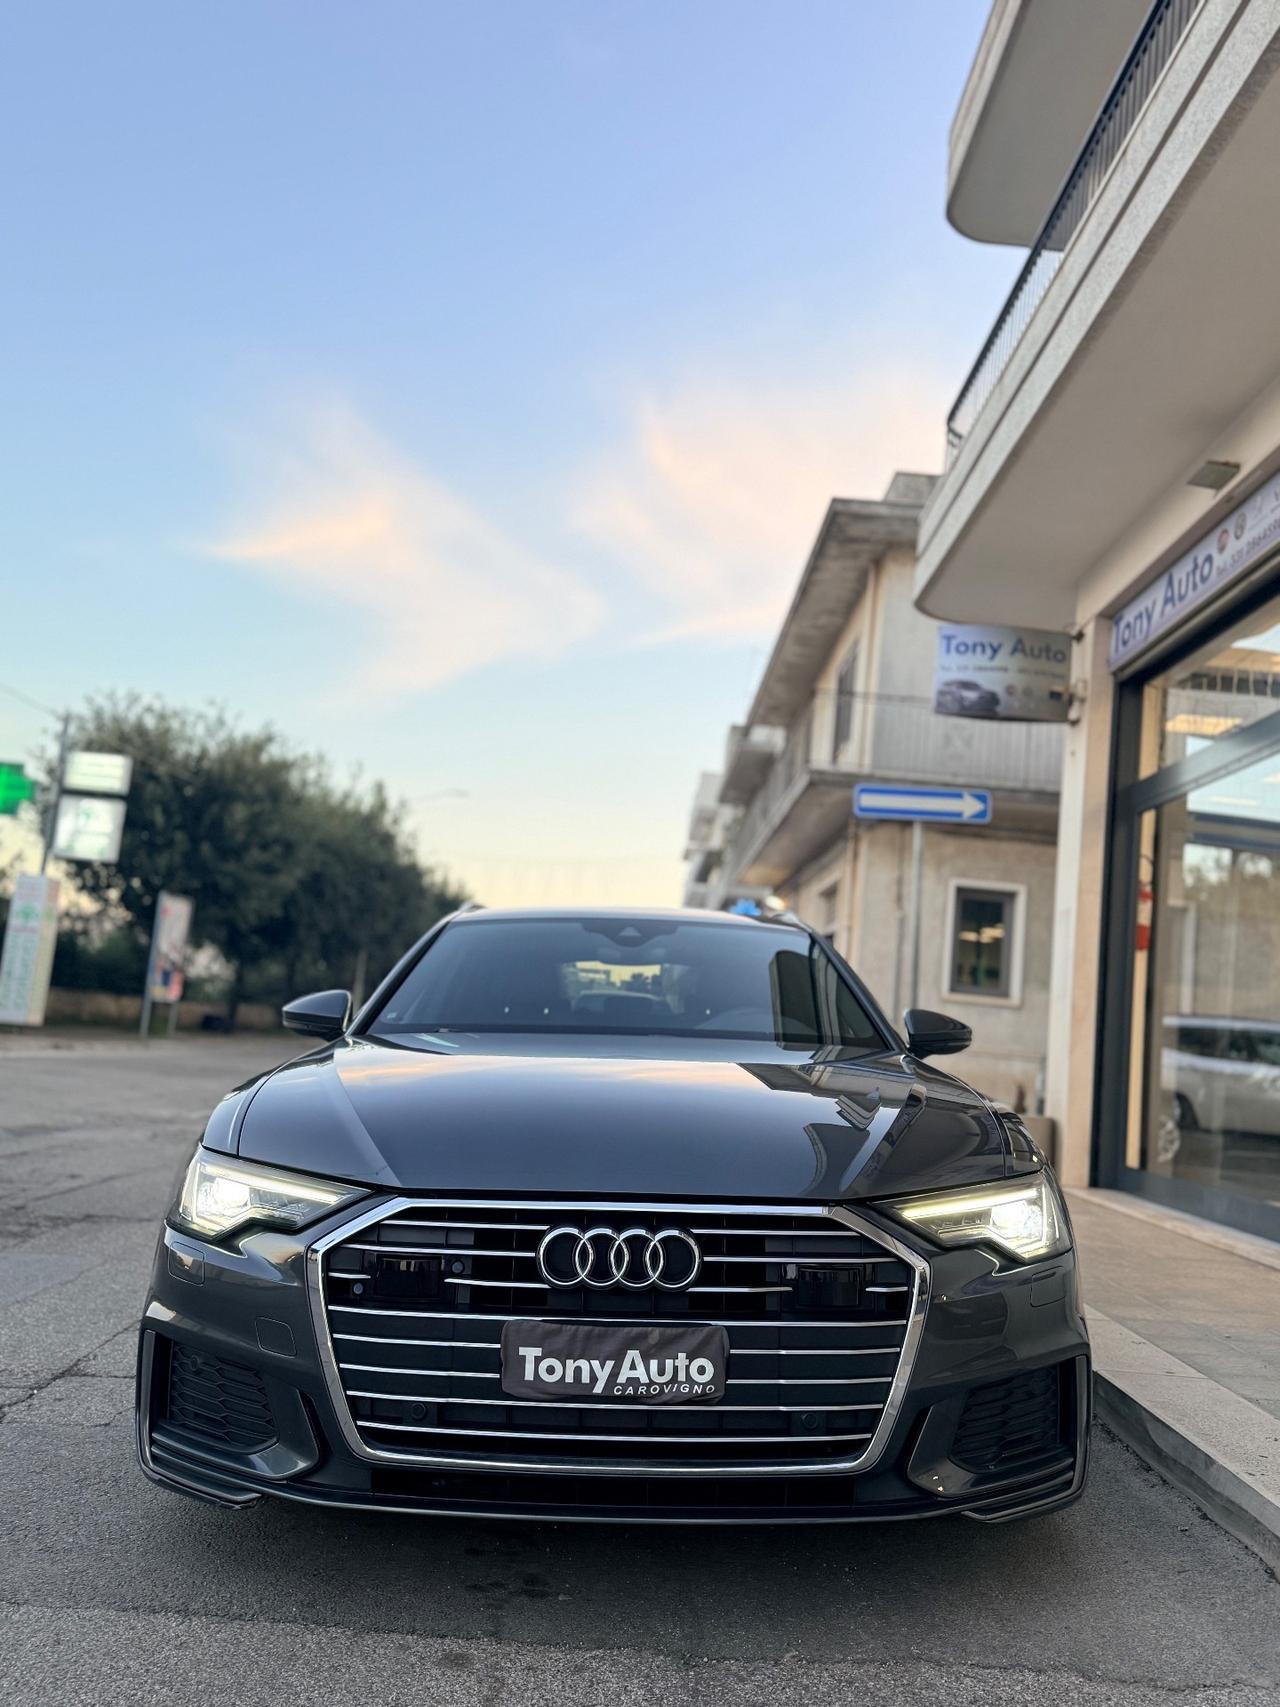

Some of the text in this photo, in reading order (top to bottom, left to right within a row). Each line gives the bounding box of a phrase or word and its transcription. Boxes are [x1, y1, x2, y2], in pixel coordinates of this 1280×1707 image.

[1113, 552, 1214, 653] Tony Auto
[943, 634, 1067, 664] Tony Auto
[518, 1346, 715, 1394] Tony Auto
[613, 1383, 715, 1395] CAROVIGNO
